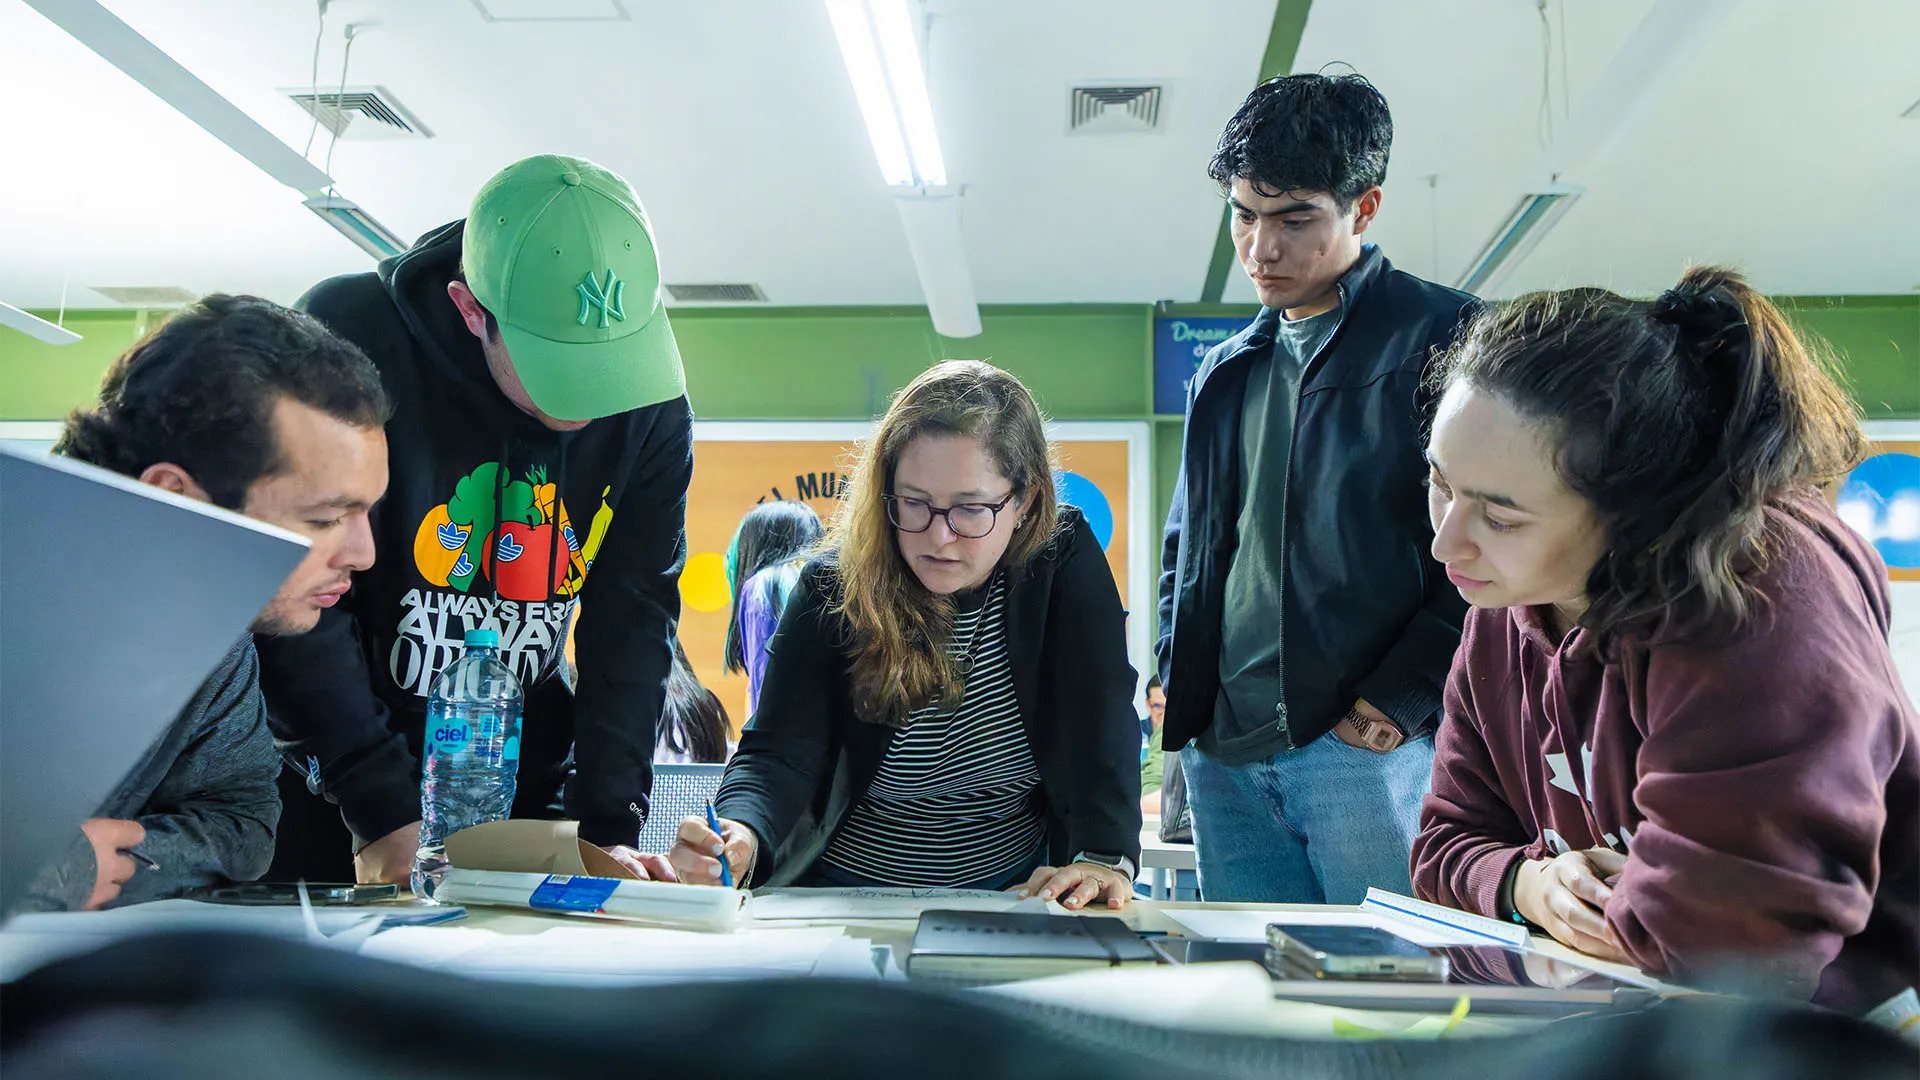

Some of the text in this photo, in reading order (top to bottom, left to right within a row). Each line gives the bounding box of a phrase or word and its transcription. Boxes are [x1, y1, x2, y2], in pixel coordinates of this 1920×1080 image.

[575, 268, 627, 329] NY
[400, 588, 520, 622] ALWAYS
[435, 724, 468, 742] ciel
